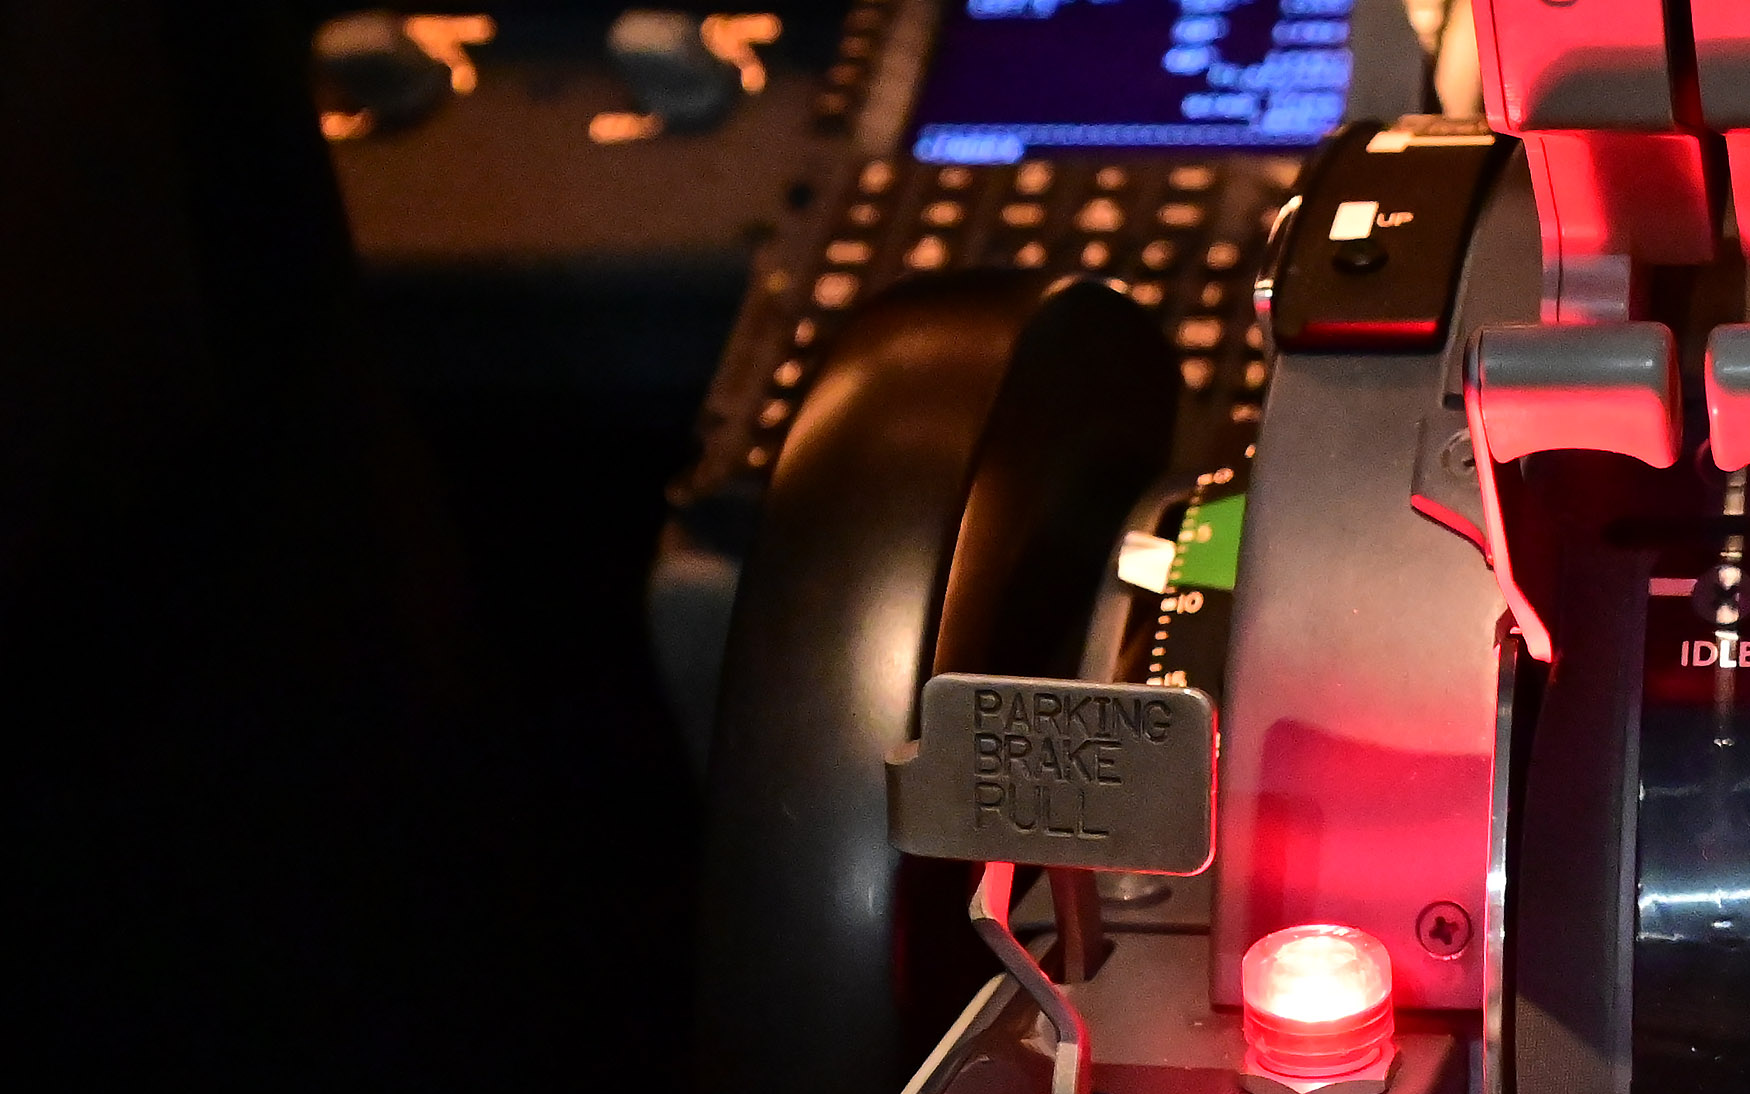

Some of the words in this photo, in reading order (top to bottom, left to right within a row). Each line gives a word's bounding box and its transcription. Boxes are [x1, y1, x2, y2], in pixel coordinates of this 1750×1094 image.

[1376, 212, 1414, 227] UP
[974, 688, 1173, 744] PARKING
[974, 733, 1122, 785] BRAKE
[974, 782, 1110, 841] PULL
